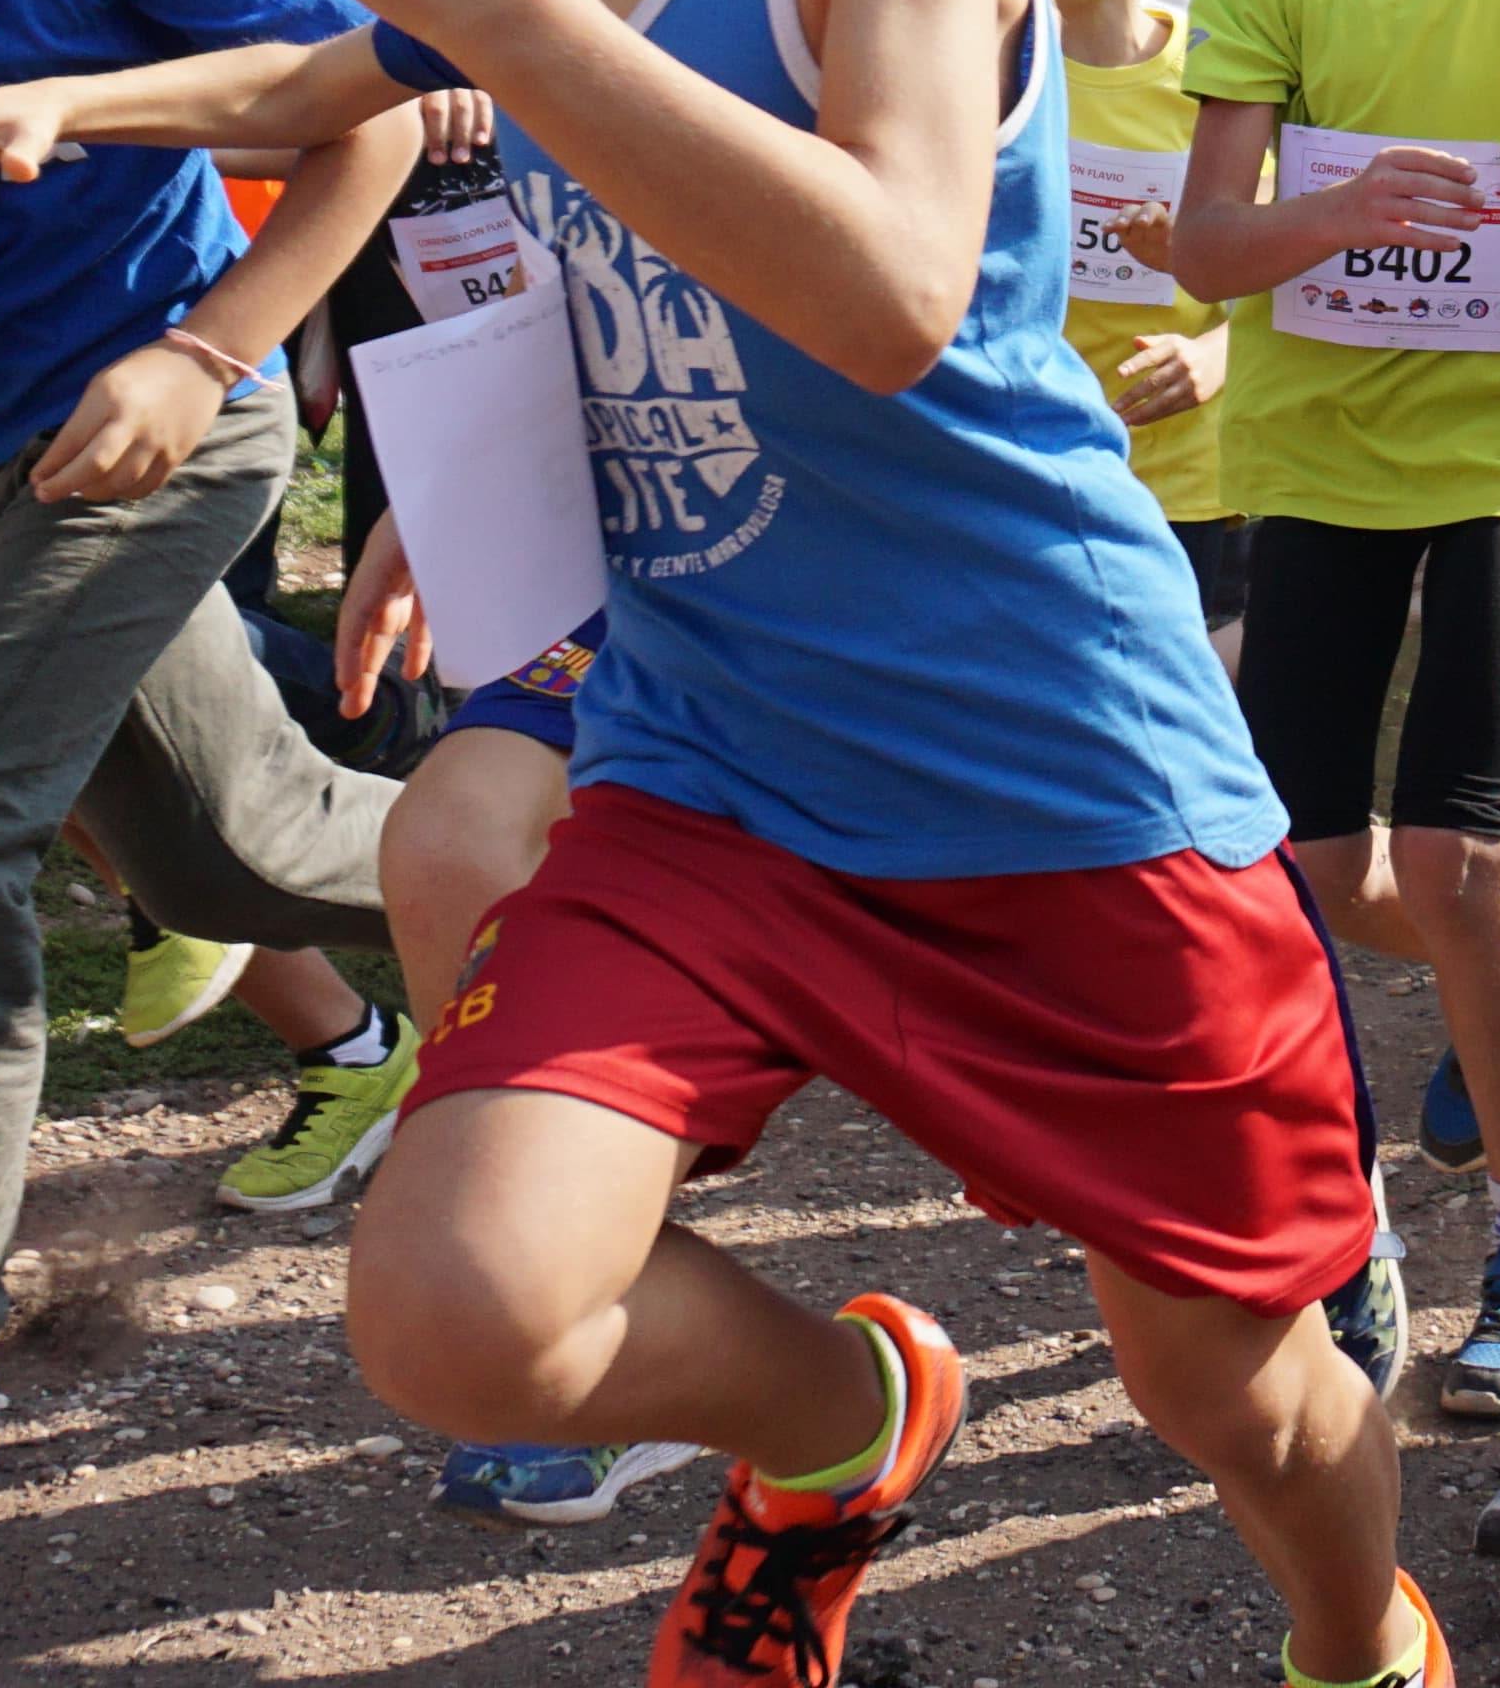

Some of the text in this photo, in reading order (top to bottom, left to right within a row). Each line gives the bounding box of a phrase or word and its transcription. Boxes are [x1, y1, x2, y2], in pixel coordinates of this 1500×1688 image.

[1069, 164, 1124, 183] ON FLAVIO
[1344, 241, 1472, 284] B402
[460, 266, 516, 306] B4
[434, 982, 498, 1044] CB
